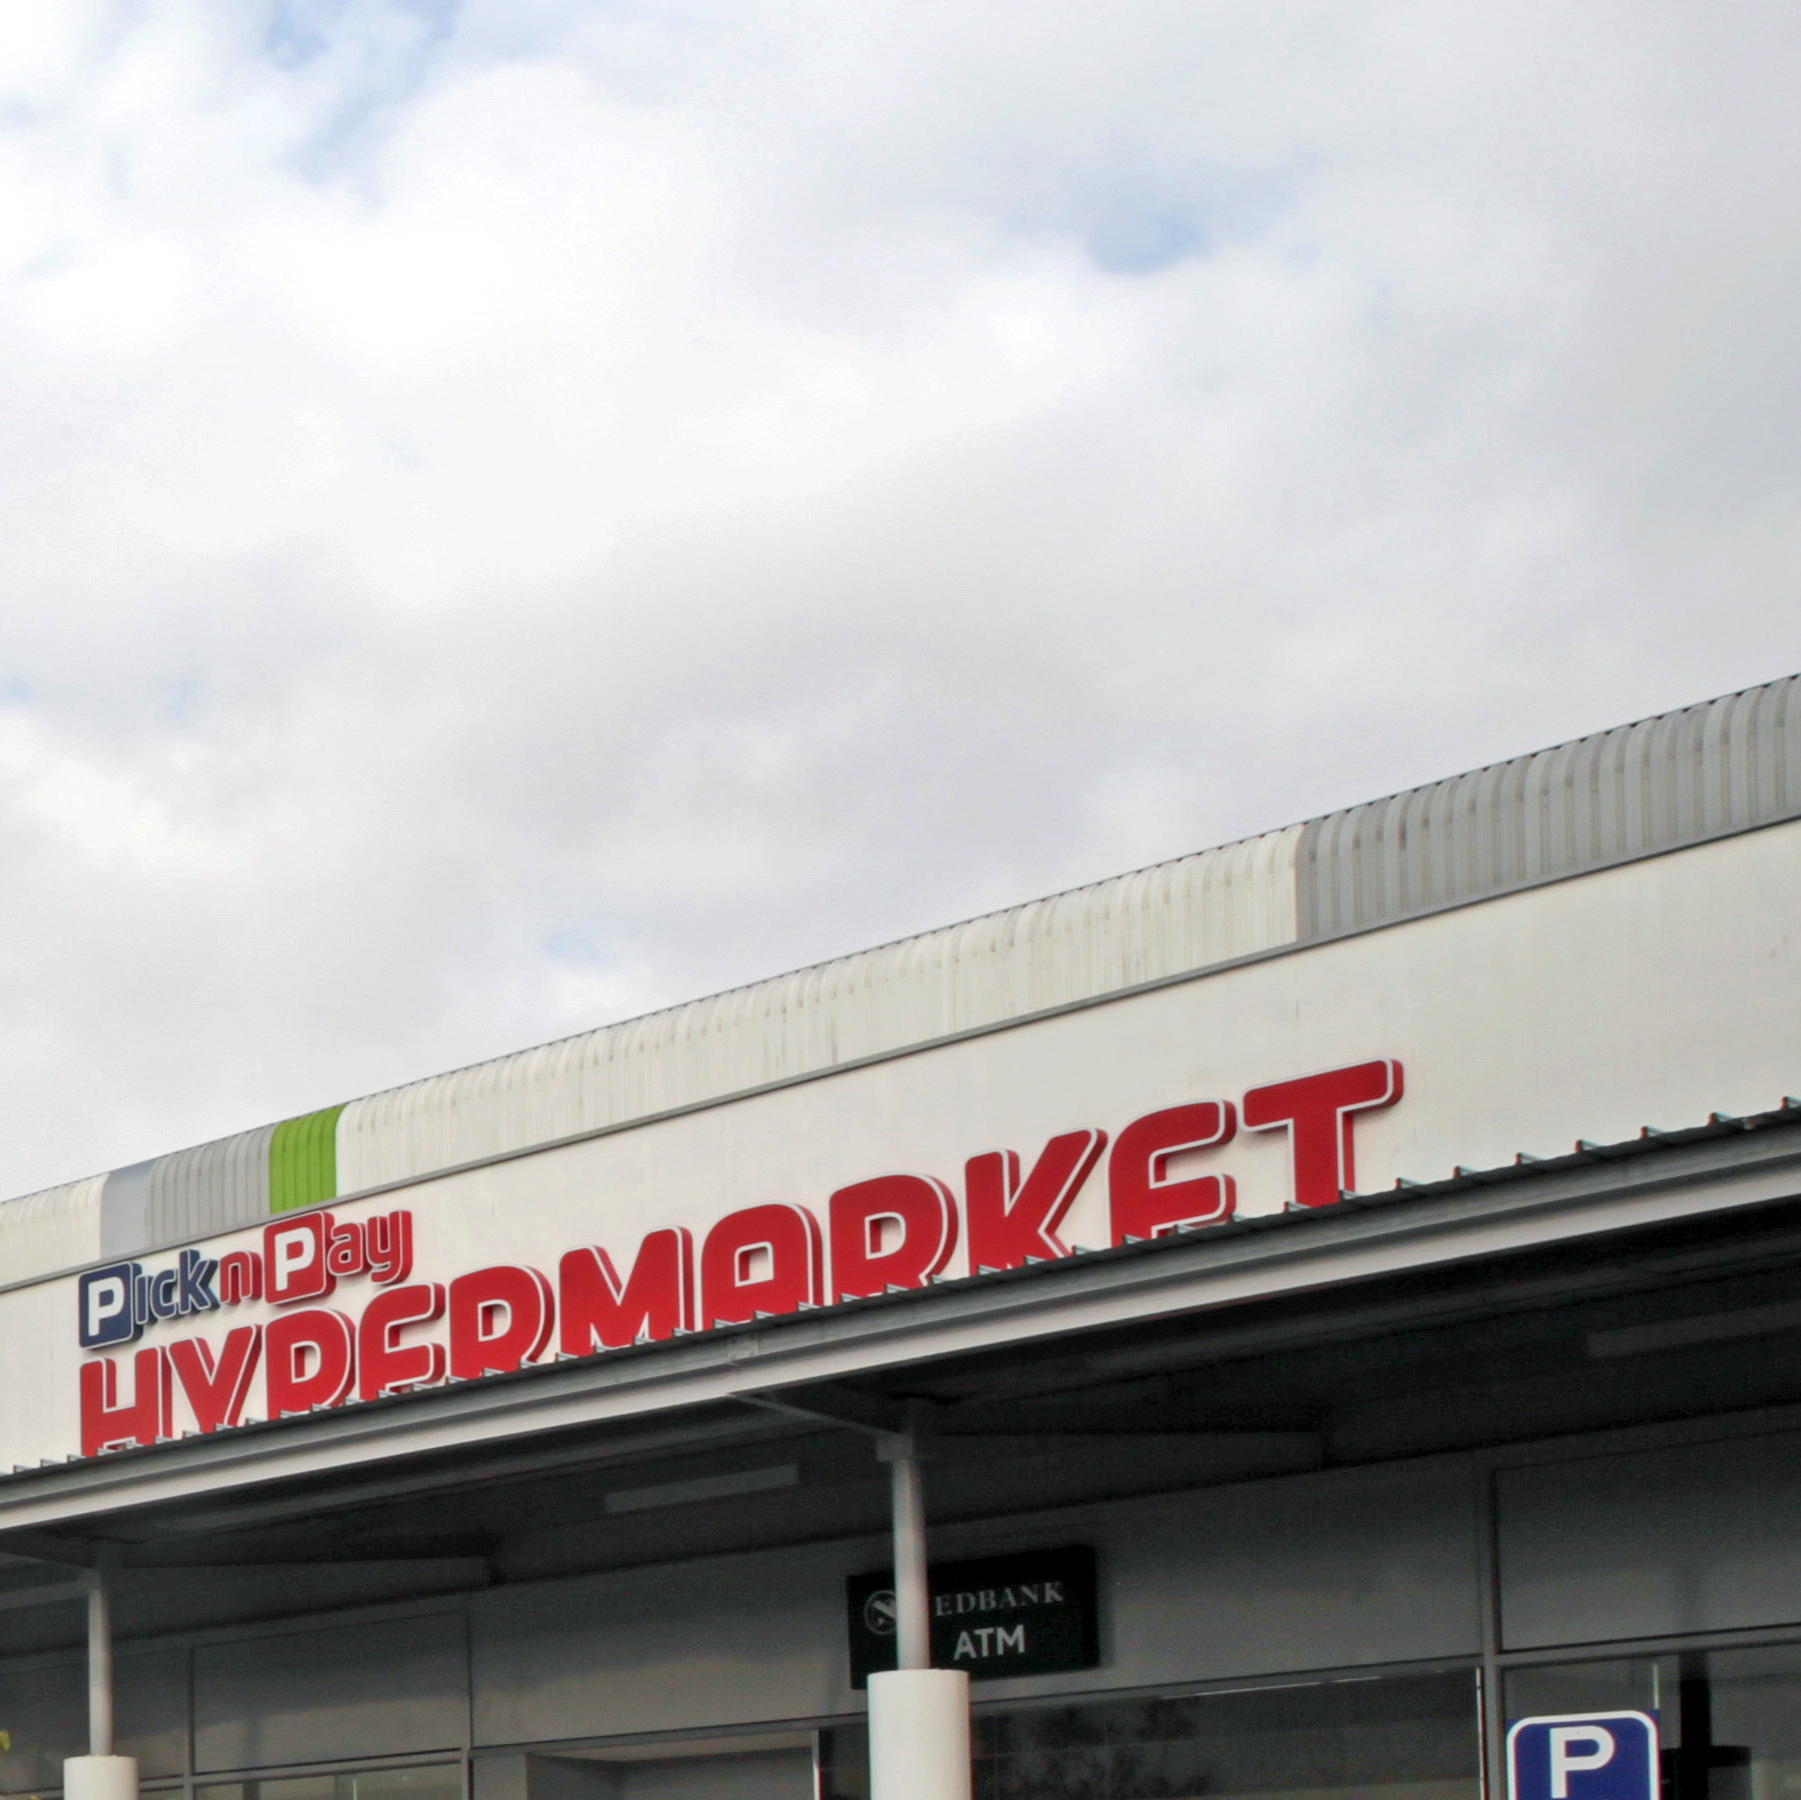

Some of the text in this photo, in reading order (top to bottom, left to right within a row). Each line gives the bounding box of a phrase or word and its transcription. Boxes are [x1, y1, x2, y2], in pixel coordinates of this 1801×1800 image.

[79, 1248, 220, 1350] Pick
[263, 1210, 413, 1304] Pay
[80, 1058, 1403, 1458] HYPERMARKET
[934, 1580, 1064, 1618] EDBANK
[953, 1623, 1026, 1661] ATM
[1549, 1725, 1616, 1799] P
